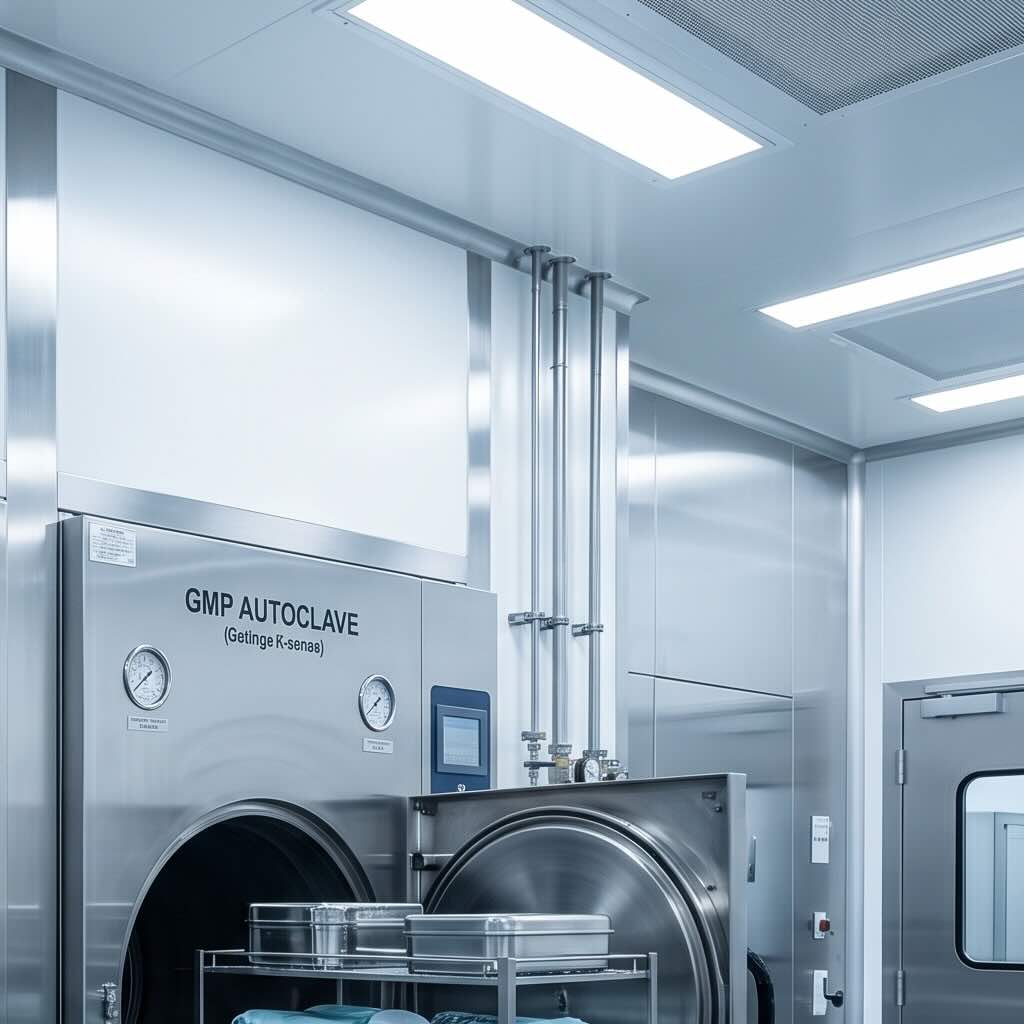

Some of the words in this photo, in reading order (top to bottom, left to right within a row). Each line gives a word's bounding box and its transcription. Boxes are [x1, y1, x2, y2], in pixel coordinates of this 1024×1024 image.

[185, 587, 234, 617] GMP
[238, 595, 360, 637] AUTOCLAVE
[224, 625, 274, 651] (Getinge
